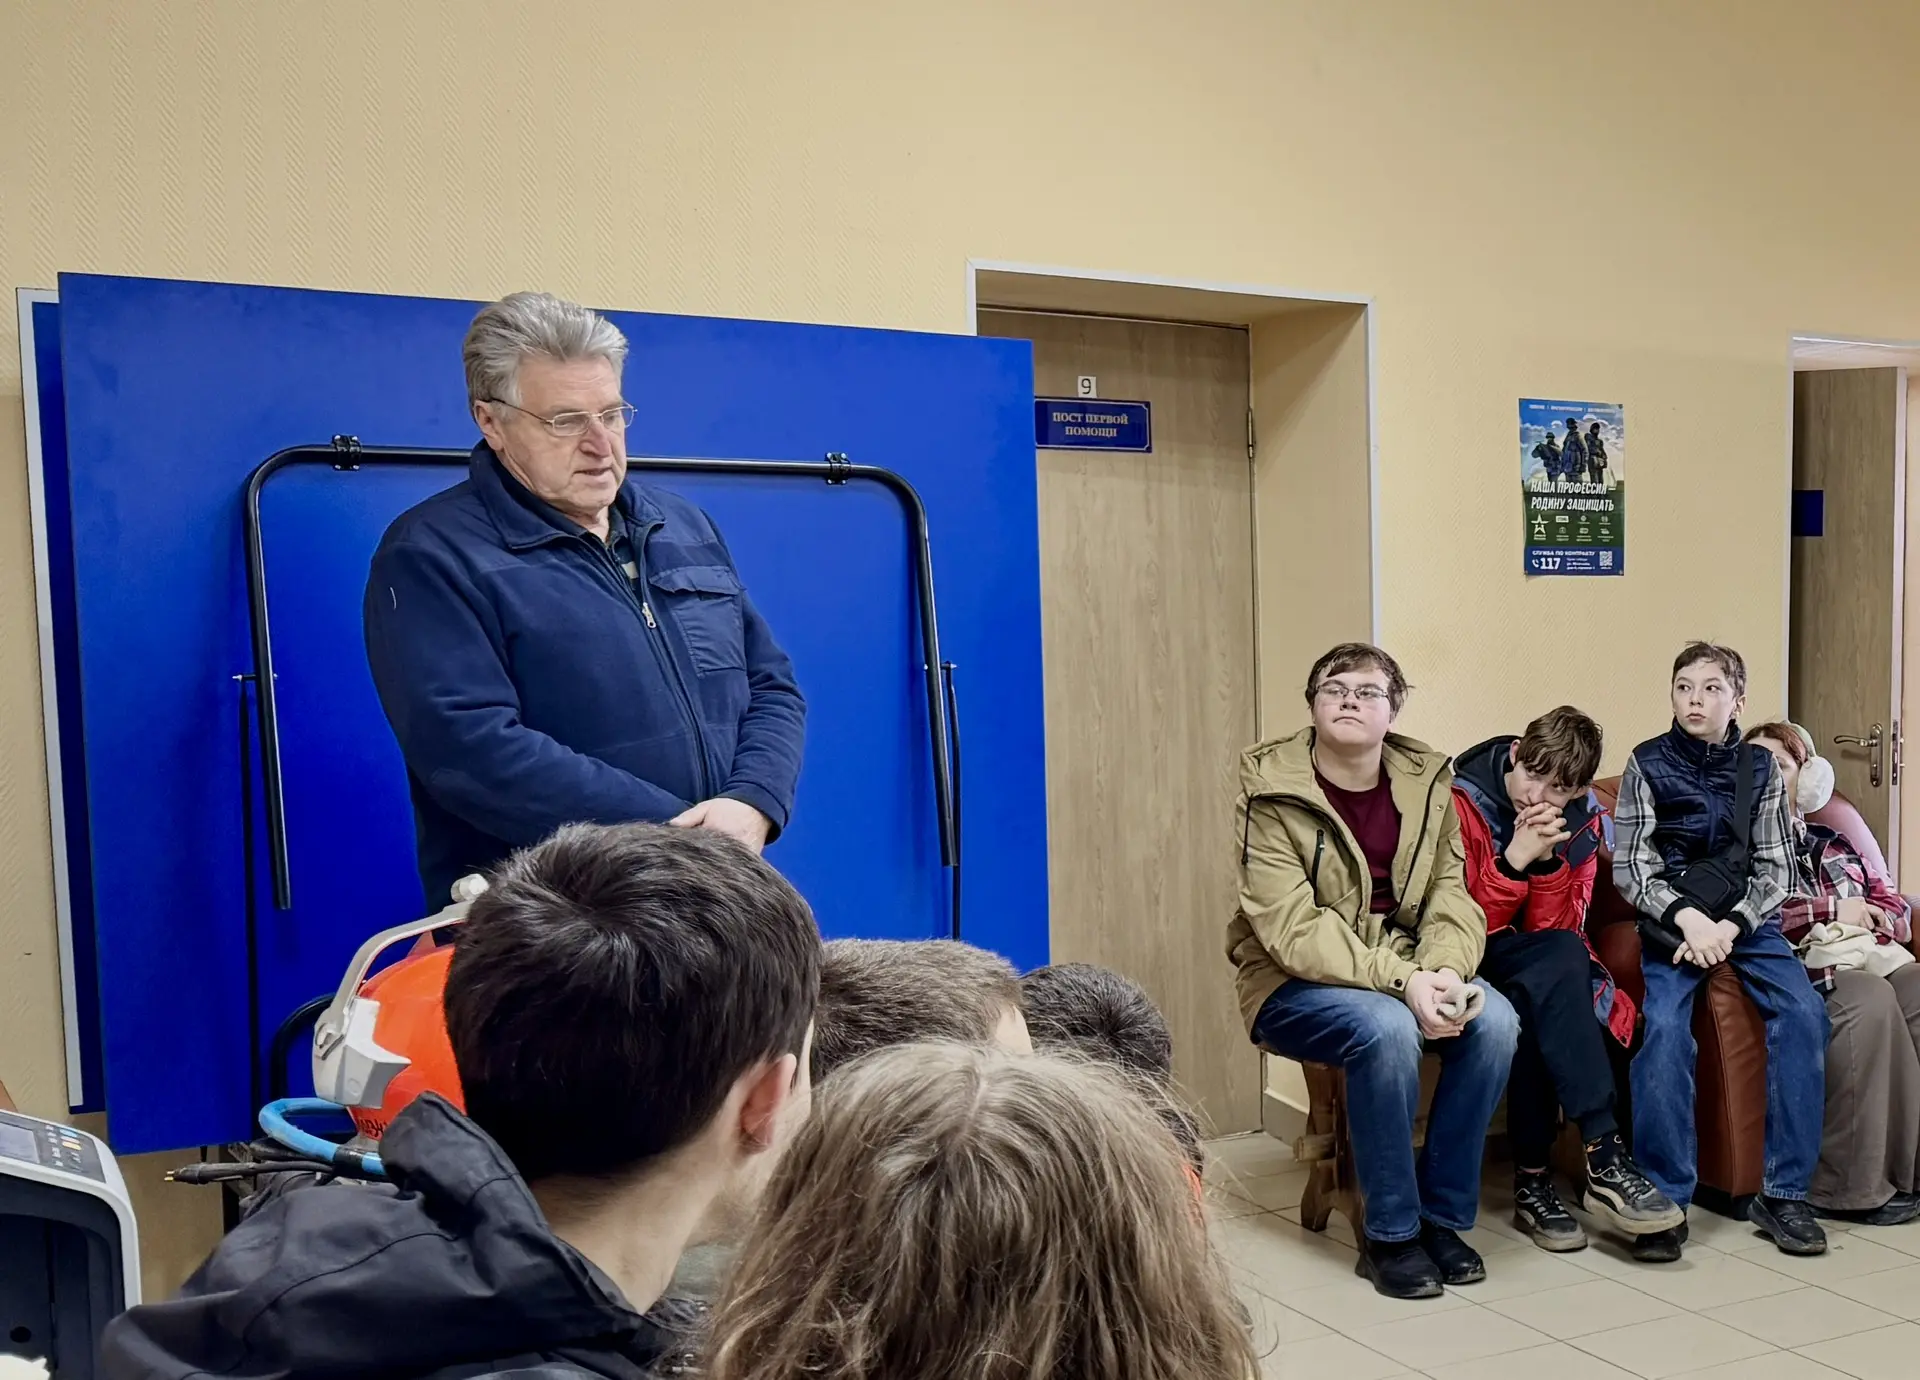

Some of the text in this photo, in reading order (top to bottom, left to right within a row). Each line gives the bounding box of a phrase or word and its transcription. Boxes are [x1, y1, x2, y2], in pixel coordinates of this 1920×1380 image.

[1081, 378, 1092, 395] 9
[1052, 412, 1128, 425] ПОСТ ПЕРВОЙ
[1065, 426, 1117, 438] ПОМОЩИ
[1530, 480, 1556, 493] НАША
[1557, 481, 1607, 495] ПРОФЕССИЯ
[1531, 497, 1615, 512] РОДИНУ ЗАЩИЩАТЬ
[1540, 557, 1561, 570] 117
